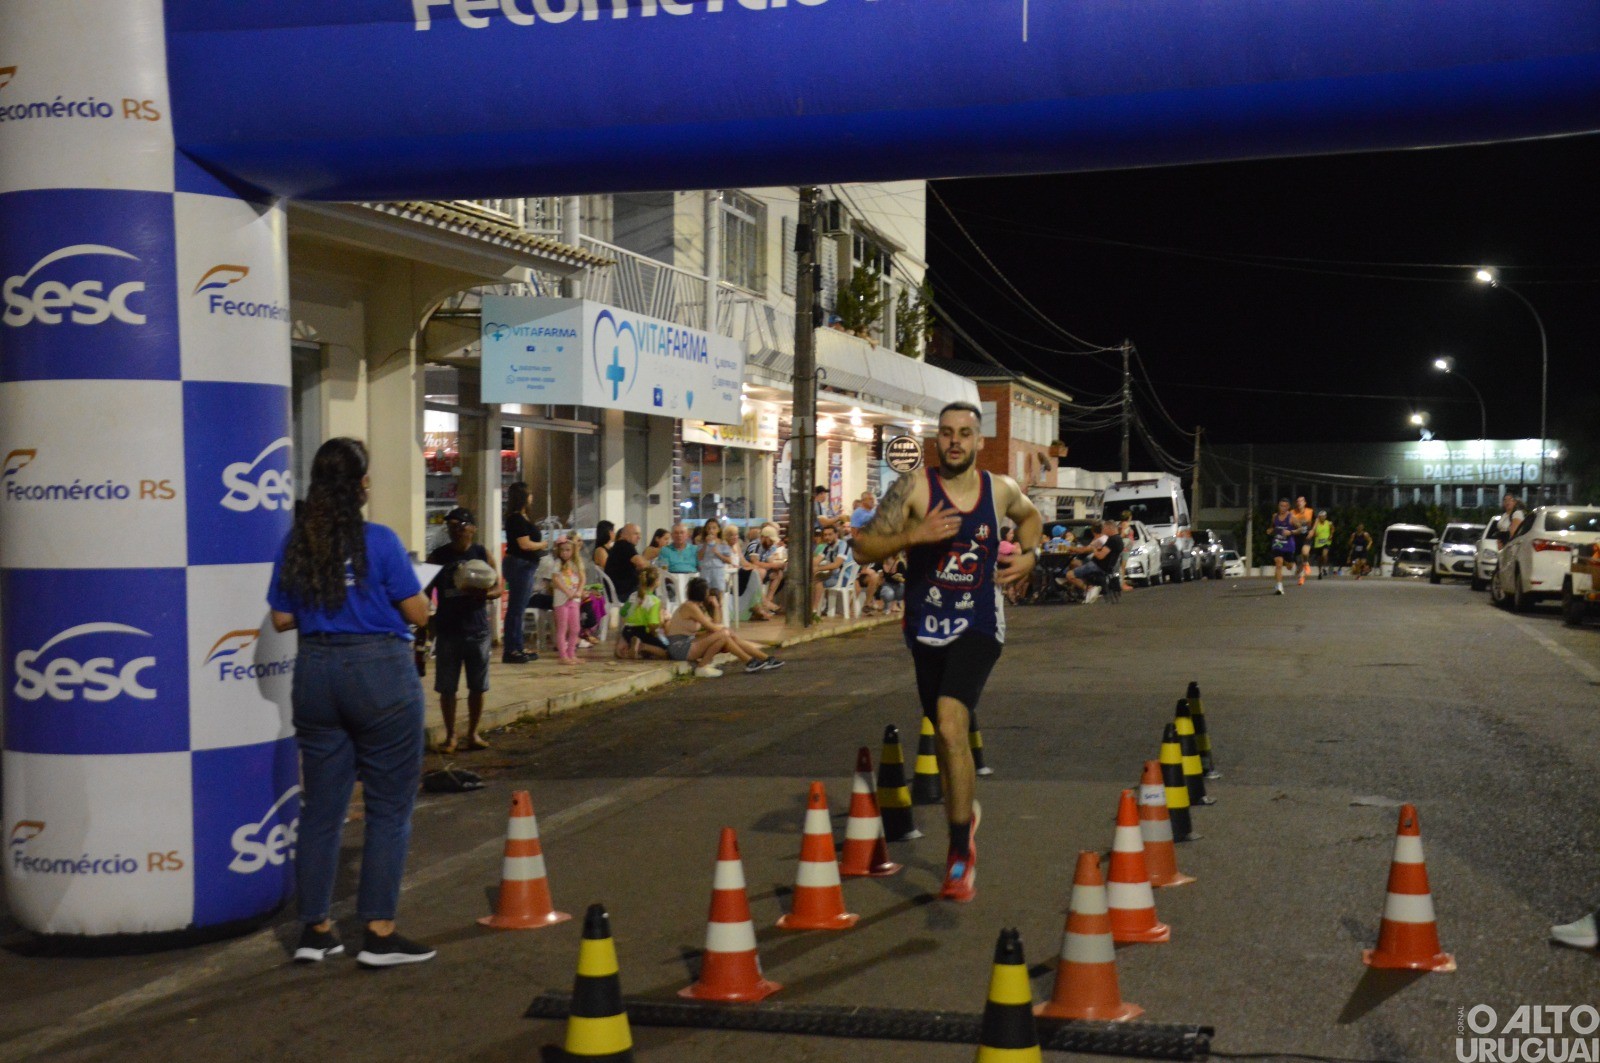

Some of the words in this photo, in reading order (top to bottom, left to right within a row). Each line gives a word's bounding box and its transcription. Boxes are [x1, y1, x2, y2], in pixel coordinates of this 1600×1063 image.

[0, 95, 114, 122] ecomércio
[121, 98, 161, 122] RS
[512, 326, 578, 338] VITAFARMA
[636, 319, 708, 365] VITAFARMA
[1423, 463, 1474, 481] PADRE
[1477, 460, 1539, 481] VITÓRIO
[7, 479, 130, 501] Fecomércio
[139, 479, 176, 500] RS
[219, 462, 296, 512] Ses
[925, 614, 969, 636] 012
[14, 850, 138, 874] Fecomércio
[147, 851, 184, 872] RS
